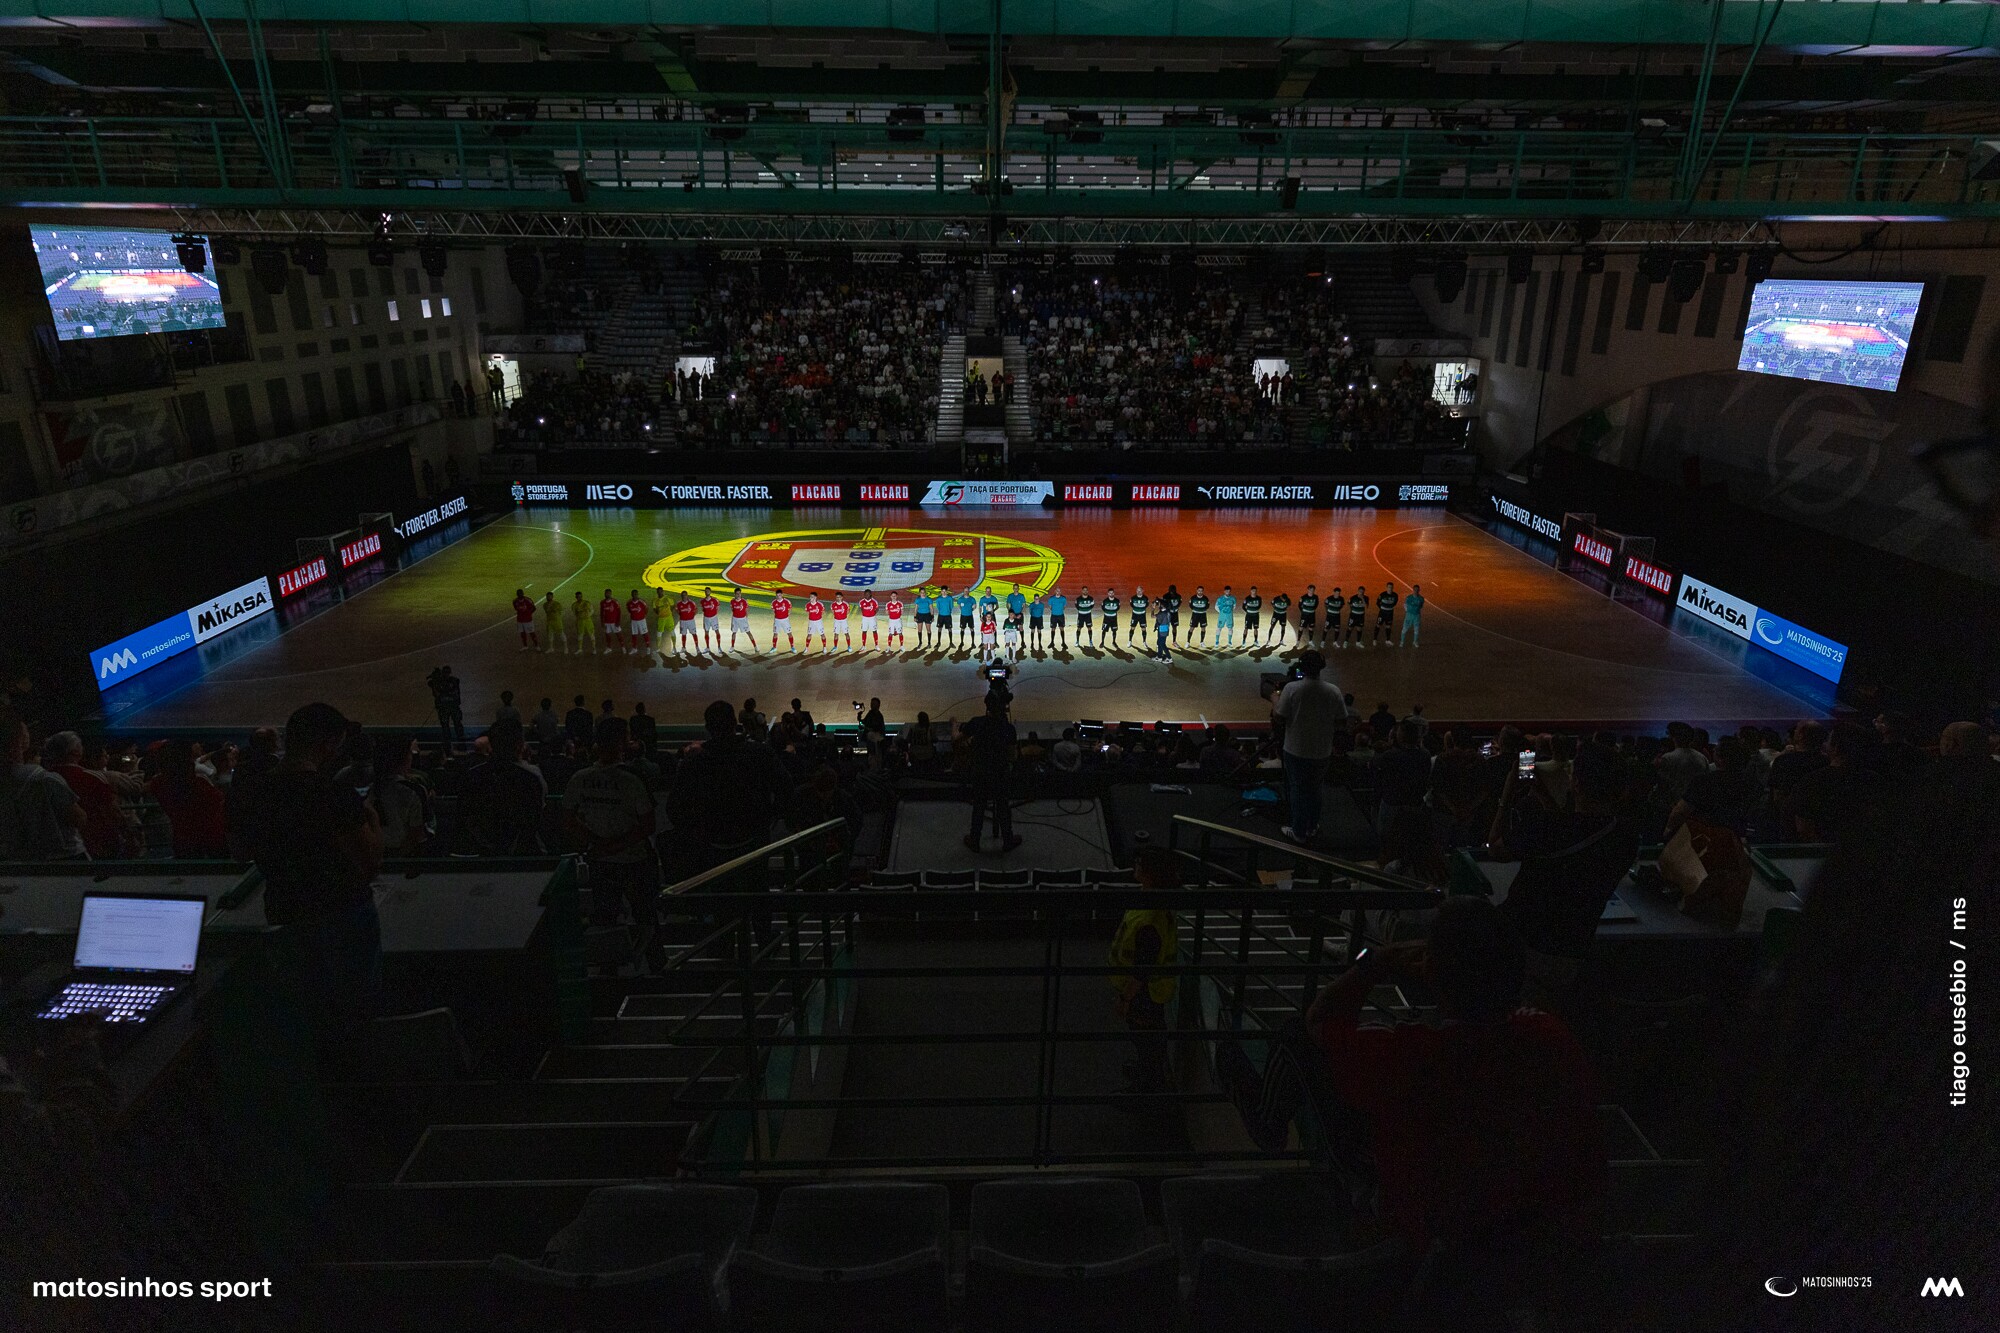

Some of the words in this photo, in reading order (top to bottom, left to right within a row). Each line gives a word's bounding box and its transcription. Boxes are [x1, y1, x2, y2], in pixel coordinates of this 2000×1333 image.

[526, 485, 568, 493] PORTUGAL
[586, 484, 633, 500] MEO
[671, 485, 725, 499] FOREVER.
[727, 485, 773, 499] FASTER.
[792, 485, 841, 499] PLACARD
[860, 485, 909, 499] PLACARD
[969, 485, 987, 494] TAÇA
[989, 485, 998, 493] DE
[1000, 485, 1038, 493] PORTUGAL
[1064, 485, 1112, 499] PLACARD
[1132, 485, 1180, 499] PLACARD
[1215, 486, 1268, 499] FOREVER.
[1270, 486, 1314, 499] FASTER.
[1334, 485, 1380, 500] MEO
[1412, 485, 1449, 493] PORTUGAL
[405, 508, 441, 537] FOREVER.
[440, 496, 468, 520] FASTER.
[1500, 501, 1531, 527] FOREVER.
[1531, 514, 1561, 541] FASTER.
[341, 534, 381, 566] PLACARD
[1575, 534, 1613, 566] PLACARD
[279, 558, 327, 595] PLACARD
[1626, 557, 1672, 593] PLACARD
[141, 631, 191, 659] matosinhos
[1786, 629, 1843, 663] MATOSINHOS'25
